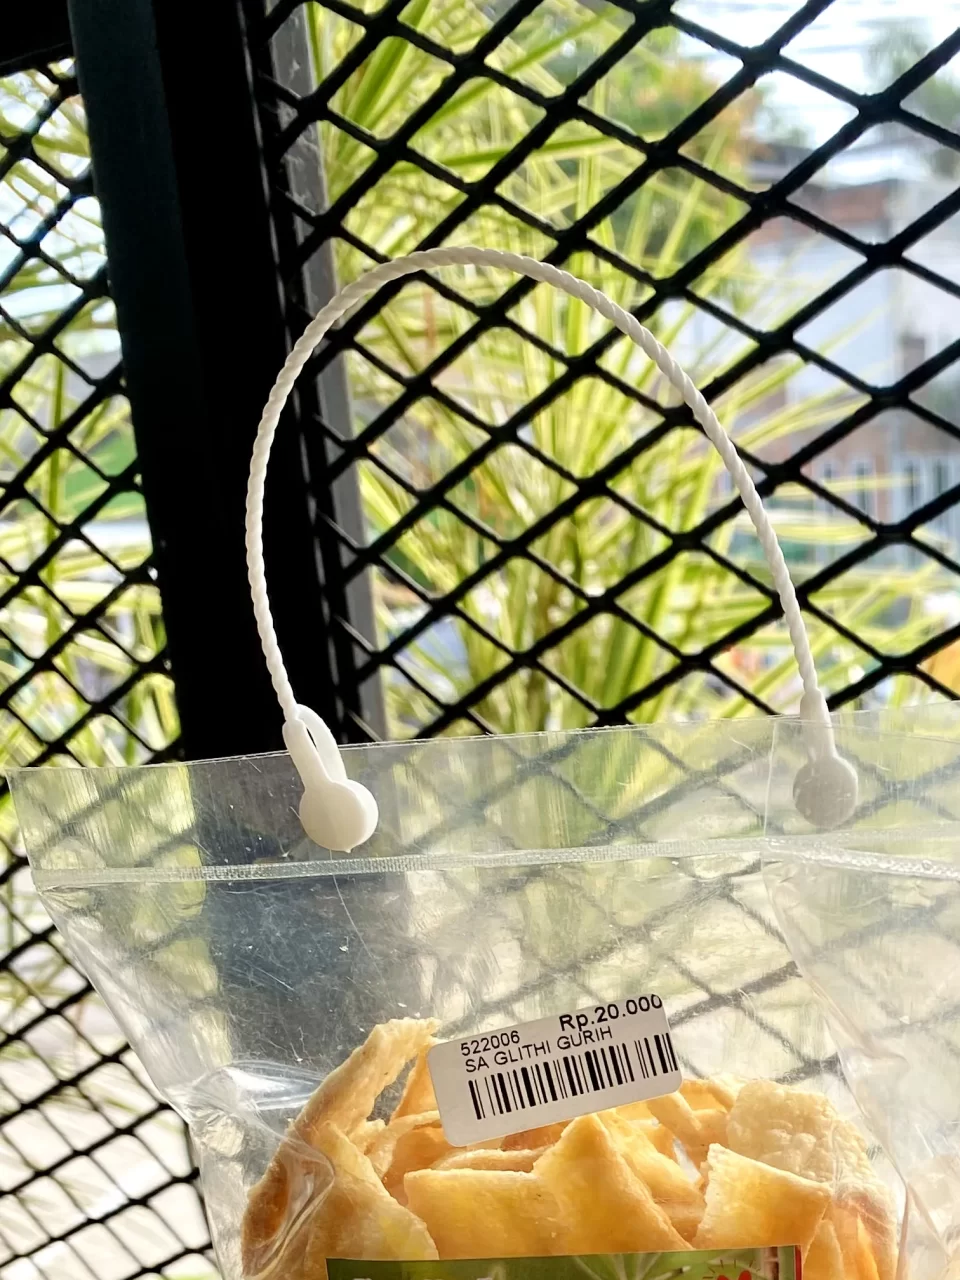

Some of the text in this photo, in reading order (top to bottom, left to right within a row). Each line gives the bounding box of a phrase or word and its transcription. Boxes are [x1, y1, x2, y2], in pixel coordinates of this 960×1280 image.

[461, 994, 663, 1056] 522006 Rp.20.000
[465, 1026, 613, 1073] SA GLITHI GURIH
